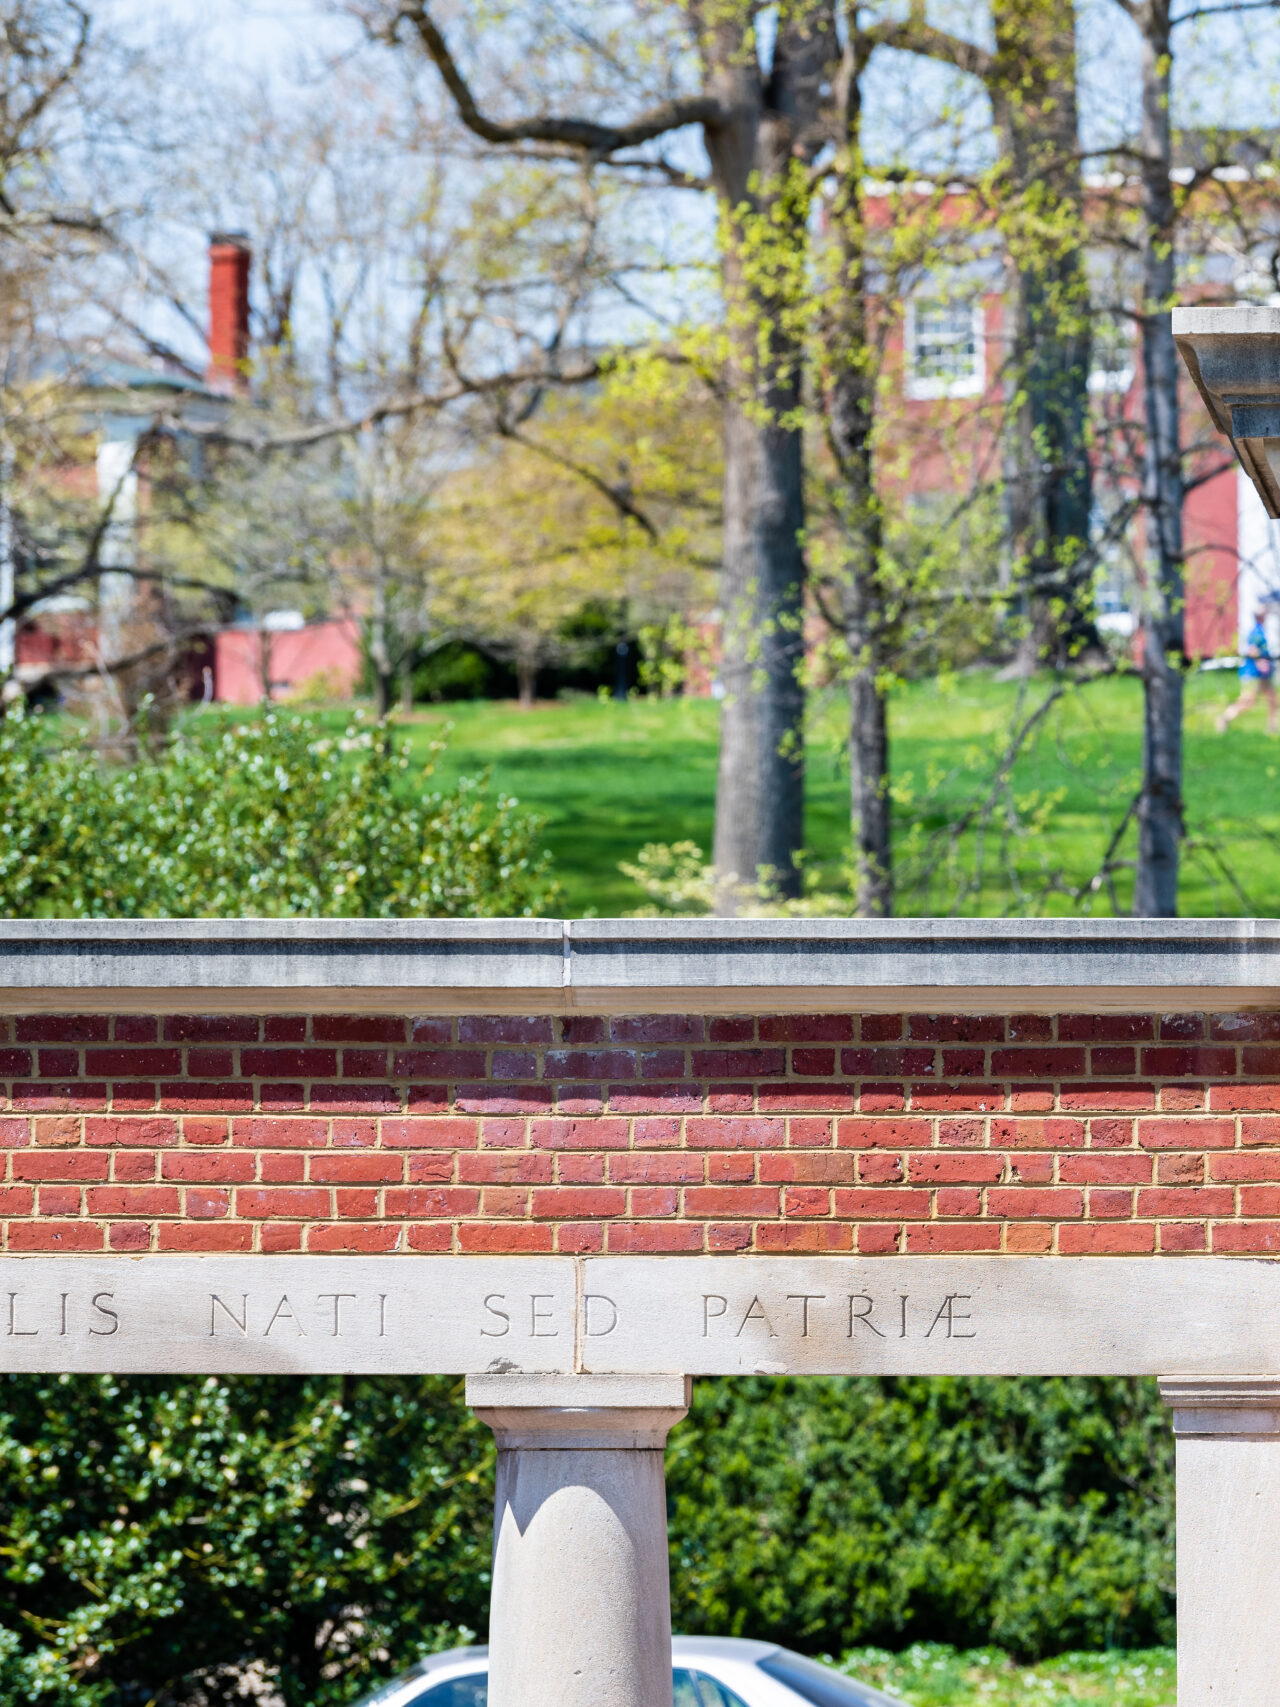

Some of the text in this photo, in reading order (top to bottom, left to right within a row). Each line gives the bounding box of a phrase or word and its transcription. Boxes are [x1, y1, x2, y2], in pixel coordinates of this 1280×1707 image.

[208, 1293, 389, 1337] NATI
[480, 1294, 619, 1337] SED
[700, 1293, 978, 1338] PATRIÆ
